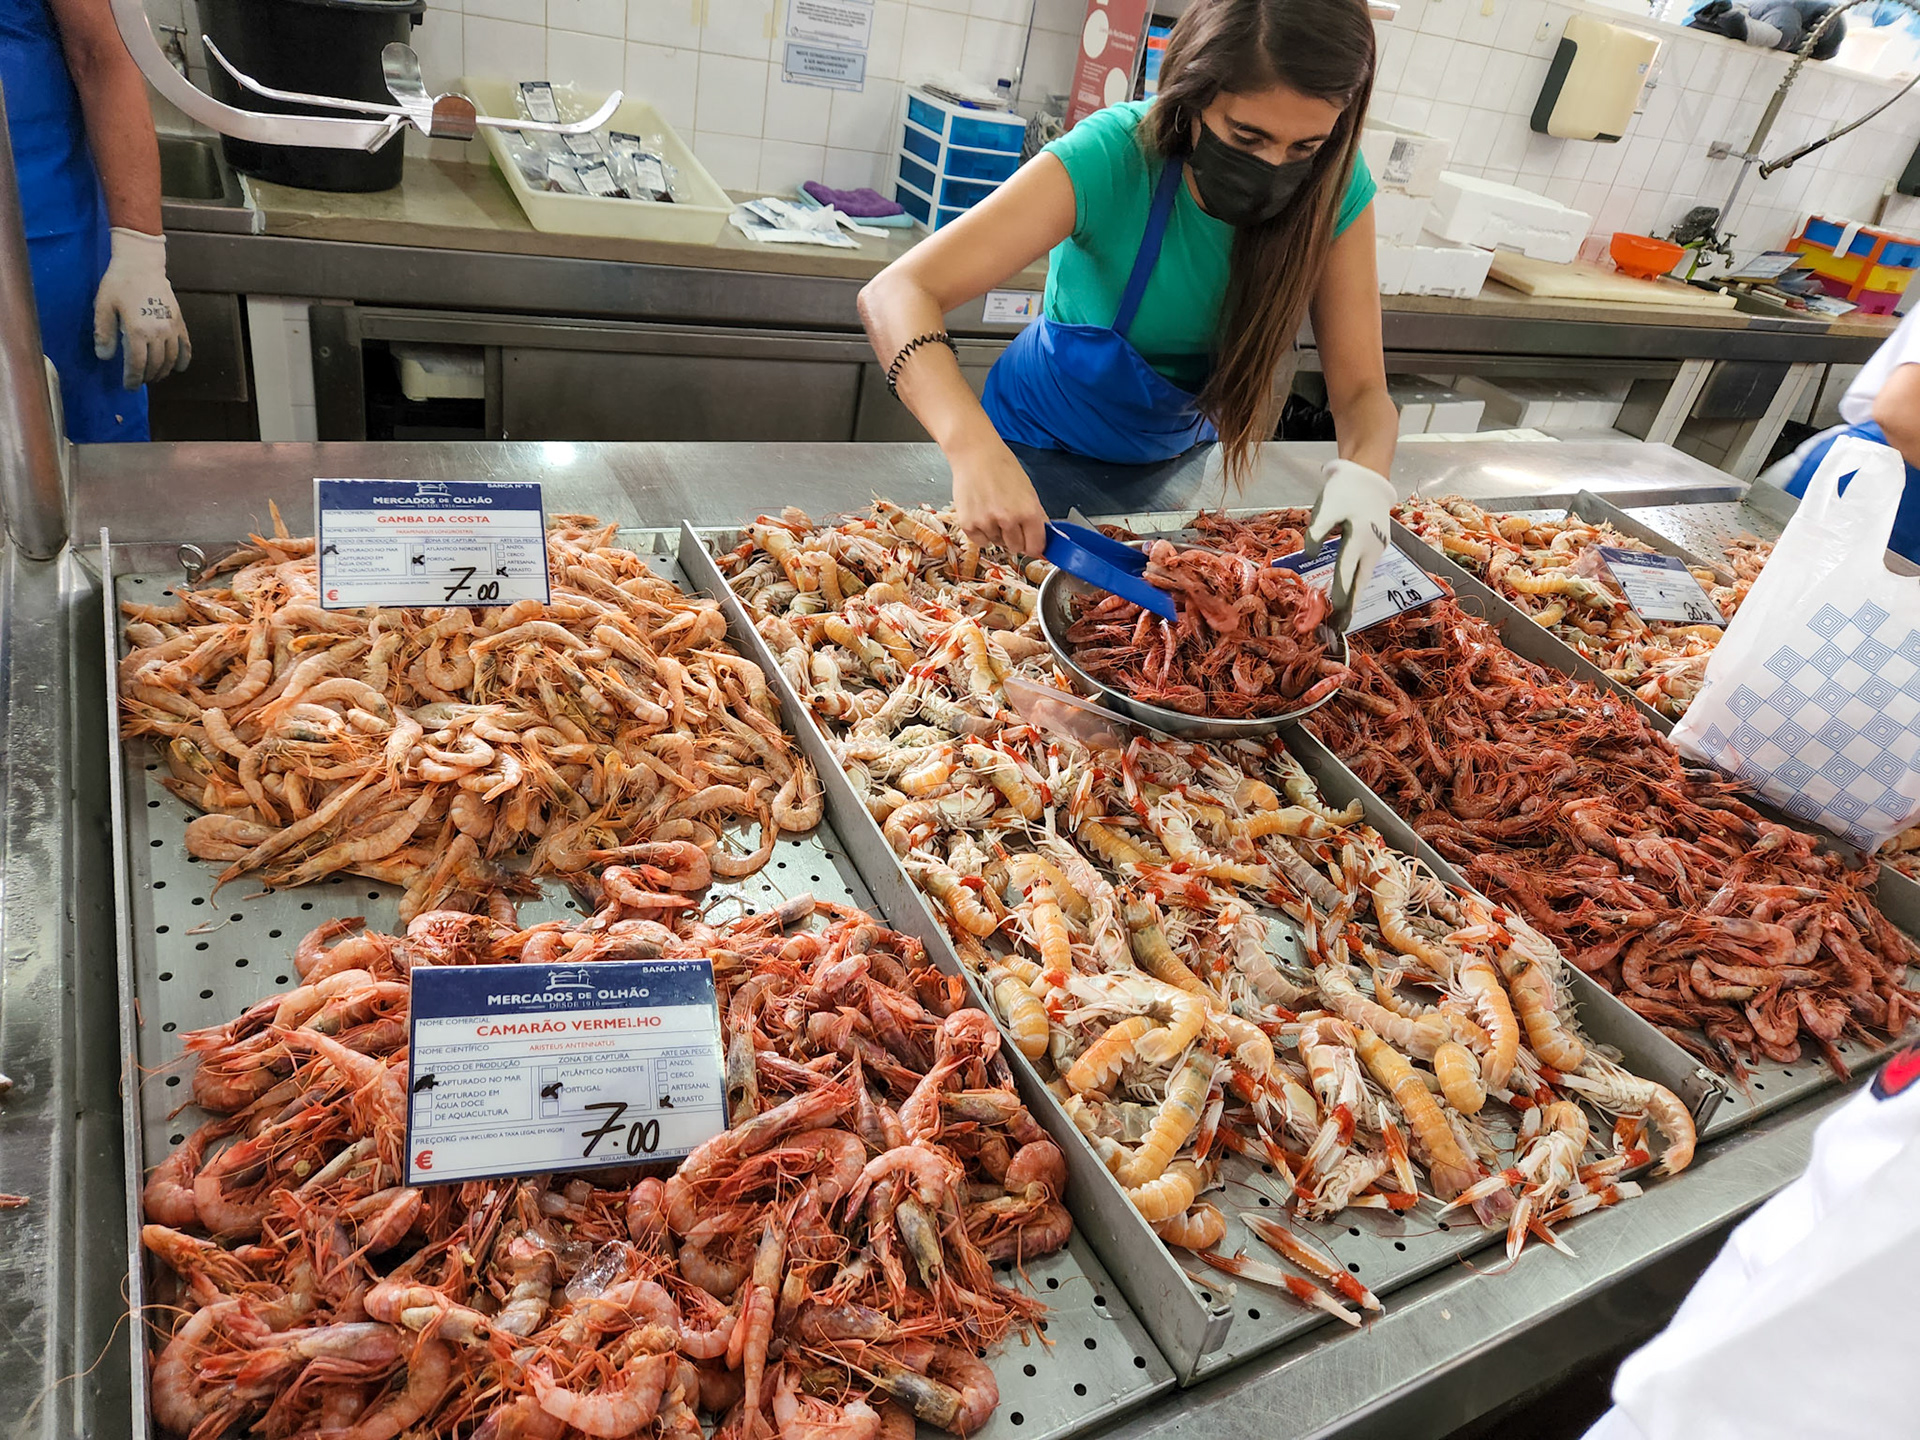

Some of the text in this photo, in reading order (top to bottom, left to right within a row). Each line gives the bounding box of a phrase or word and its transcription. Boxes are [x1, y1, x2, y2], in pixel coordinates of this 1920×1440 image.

[373, 496, 436, 504] MERCADOS
[453, 496, 493, 504] OLHÃO
[443, 566, 500, 602] 7.00
[326, 589, 339, 601] €
[642, 965, 676, 974] BANCA
[487, 986, 650, 1006] MERCADOS DE OLHÃO
[549, 1001, 579, 1009] DESDE
[419, 1017, 490, 1027] NOME COMERCIAL
[476, 1019, 567, 1036] CAMARÃO
[418, 1044, 490, 1055] NOME CIENTÍFICO
[529, 1041, 616, 1051] ARISTEUS ANTENNATUS
[558, 1056, 581, 1064] ZONA
[595, 1052, 630, 1060] CAPTURA
[424, 1064, 460, 1073] MÉTODO
[475, 1060, 521, 1069] PRODUÇÃO
[560, 1065, 645, 1077] ATLÂNTICO NORDESTE
[437, 1076, 487, 1087] CAPTURADO
[504, 1074, 521, 1082] MAR
[561, 1085, 602, 1094] PORTUGAL
[671, 1083, 711, 1091] ARTESANAL
[435, 1091, 487, 1101] CAPTURADO
[671, 1095, 705, 1103] ARRASTO
[435, 1099, 485, 1109] ÁGUA DOCE
[448, 1108, 509, 1119] AQUACULTURA
[581, 1102, 660, 1157] 7.00
[415, 1134, 457, 1145] PREÇO/KG
[415, 1150, 433, 1170] €
